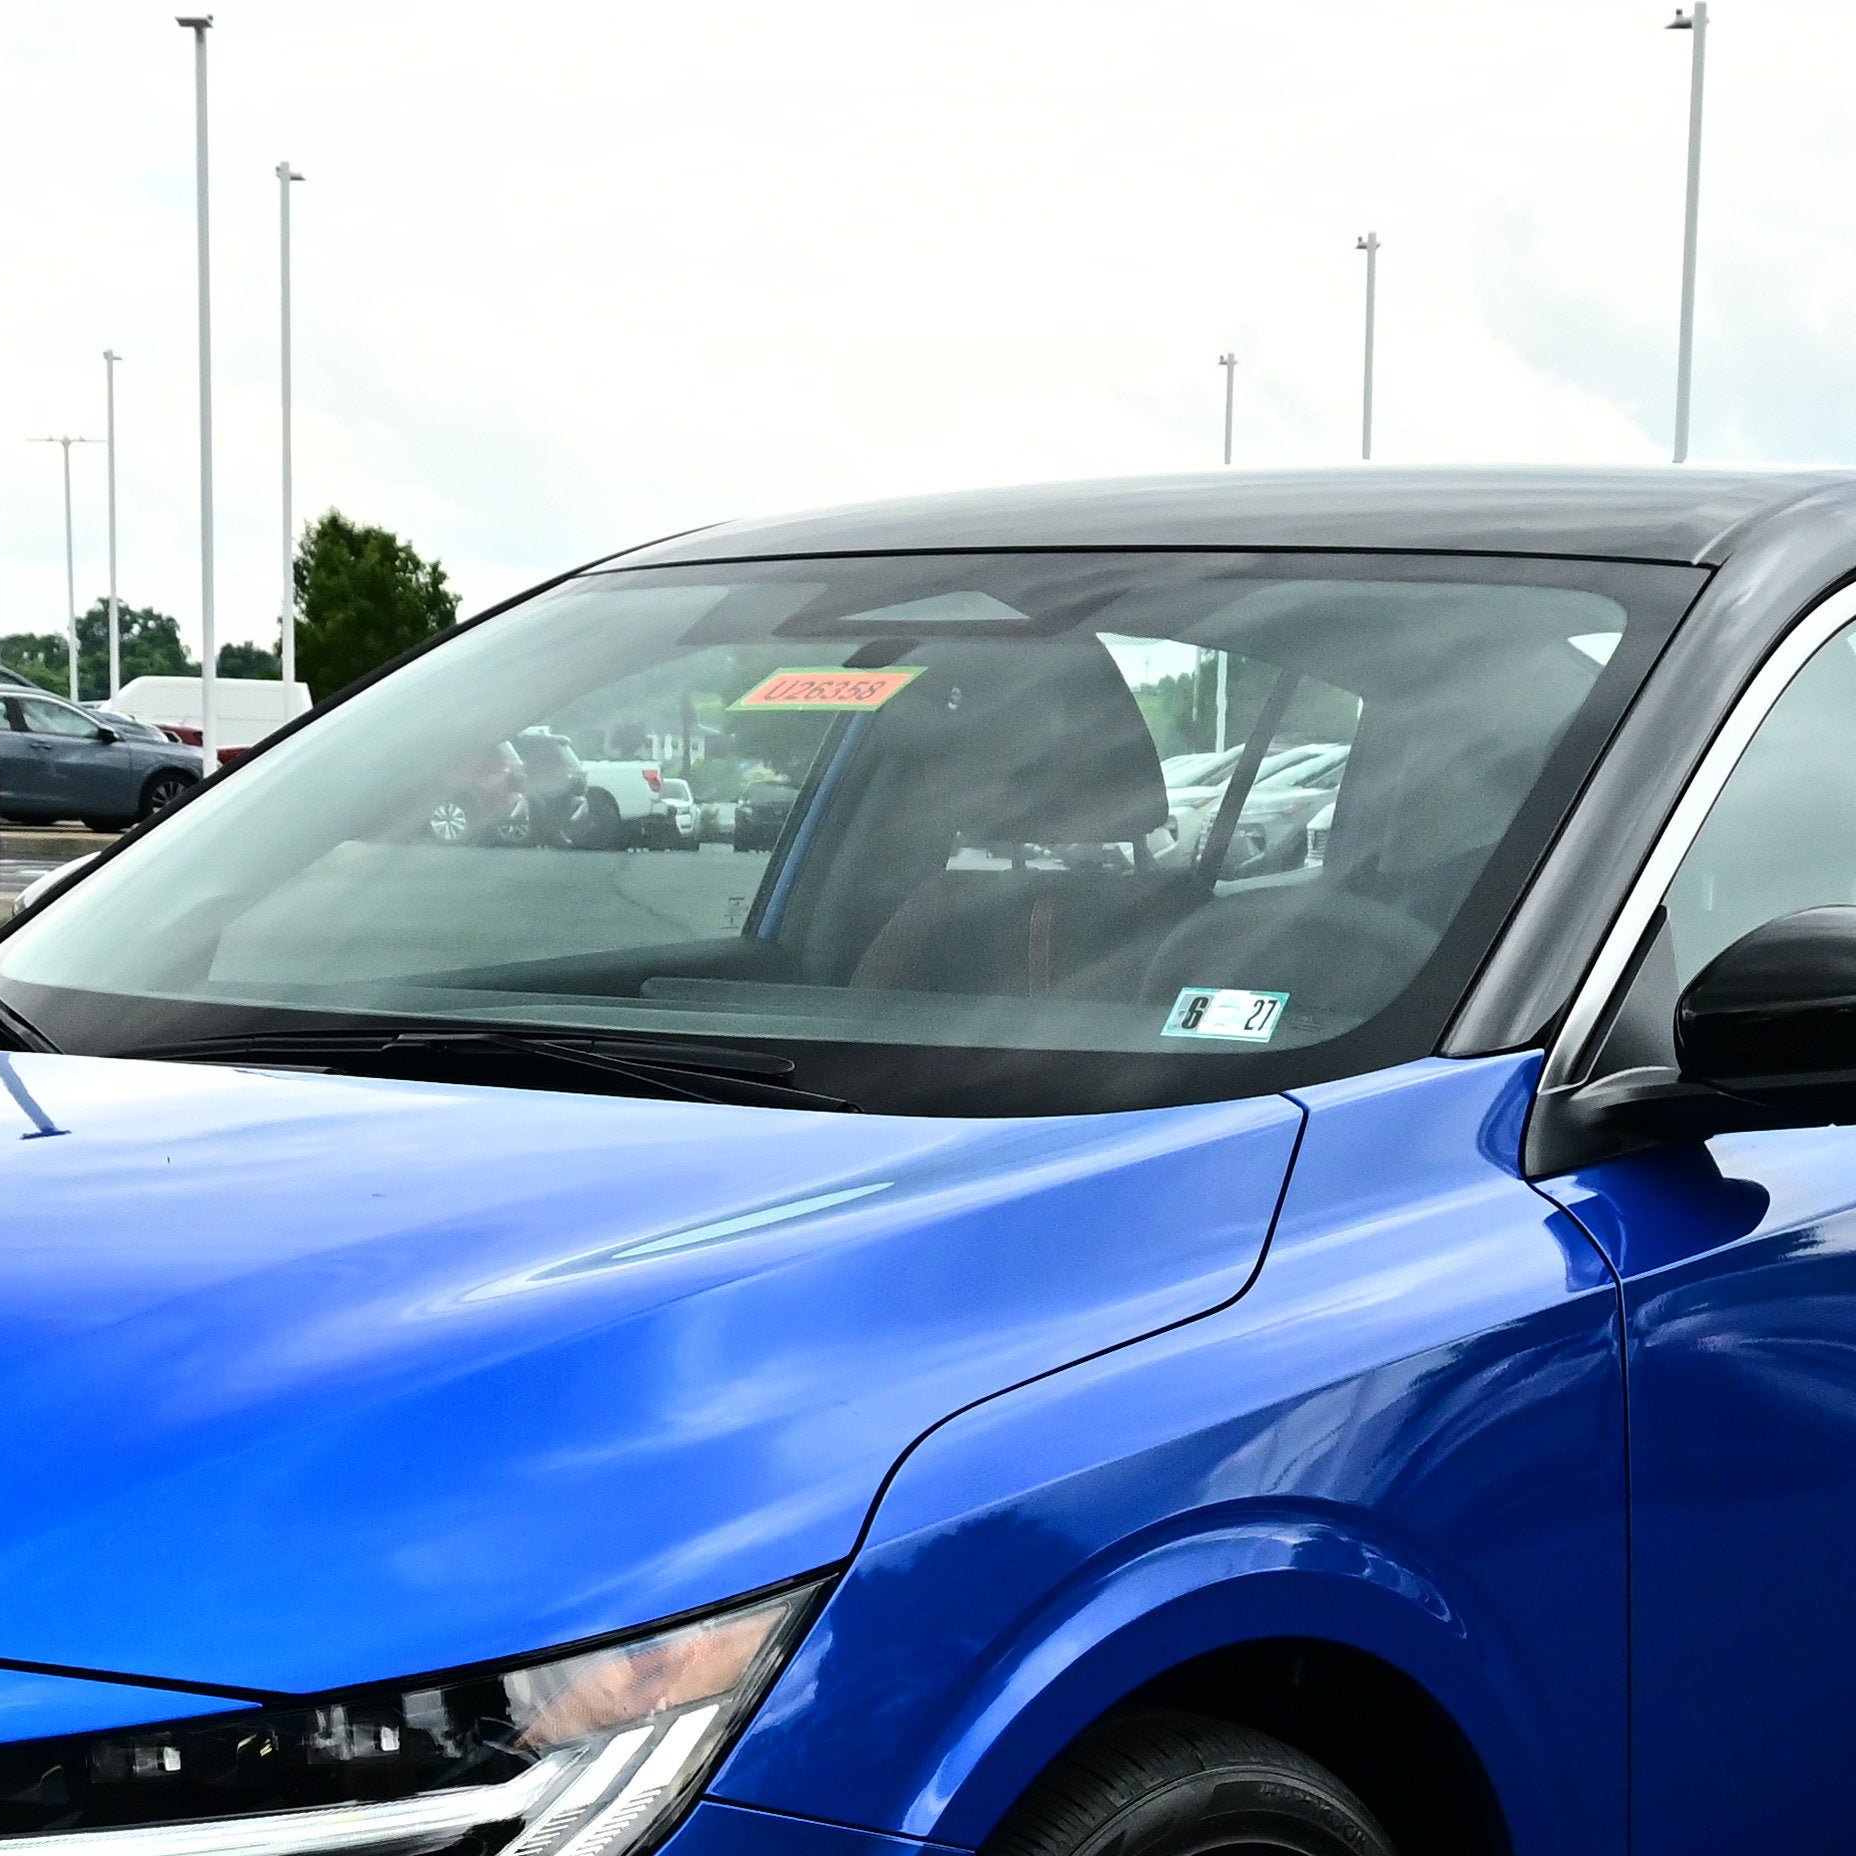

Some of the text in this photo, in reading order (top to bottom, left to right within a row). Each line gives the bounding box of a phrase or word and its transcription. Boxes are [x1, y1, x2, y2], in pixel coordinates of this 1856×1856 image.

[764, 680, 887, 701] U26358
[1181, 996, 1210, 1030] 6
[1244, 999, 1282, 1032] 27
